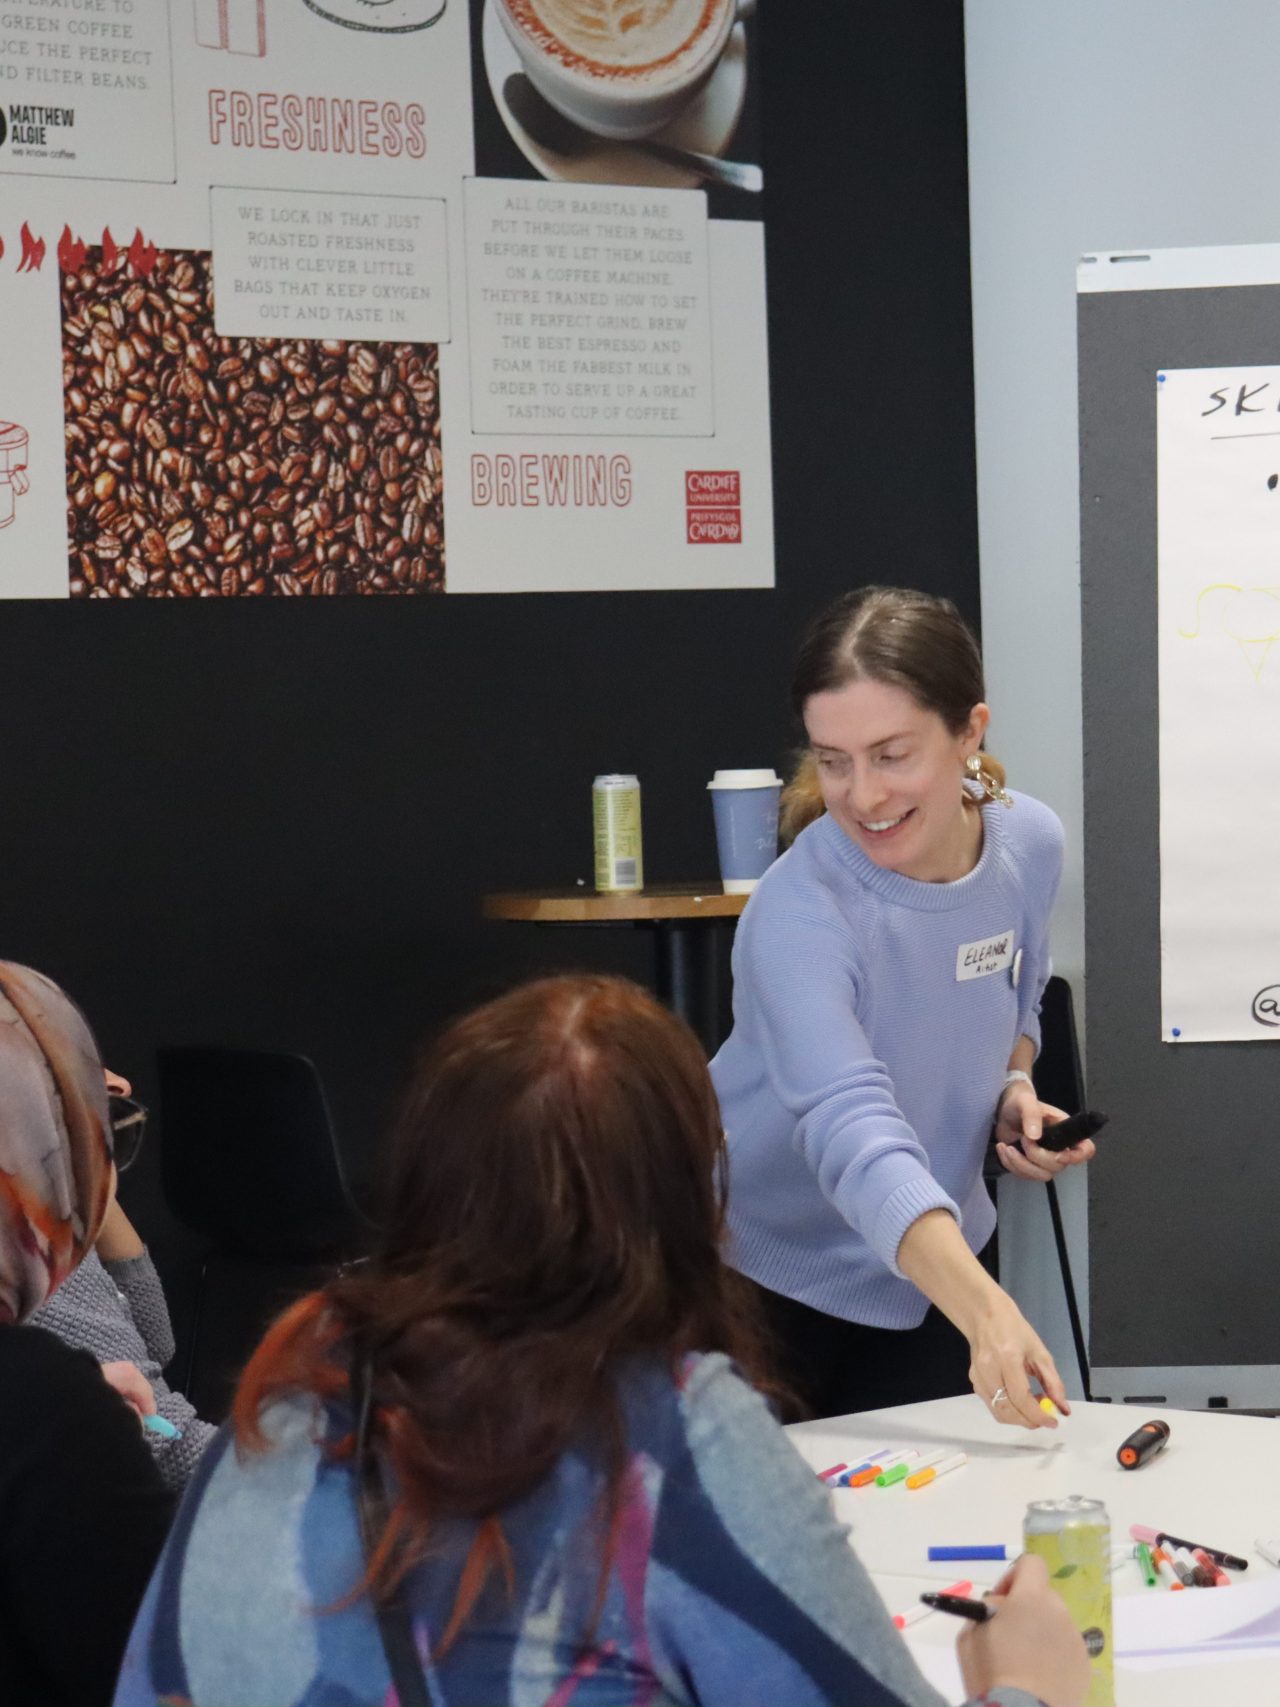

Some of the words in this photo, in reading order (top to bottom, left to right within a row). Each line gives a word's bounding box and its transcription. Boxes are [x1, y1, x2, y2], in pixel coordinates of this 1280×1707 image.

[112, 0, 134, 14] TO
[2, 14, 60, 32] GREEN
[67, 19, 133, 39] COFFEE
[36, 42, 71, 59] THE
[79, 45, 152, 65] PERFECT
[26, 67, 84, 85] FILTER
[9, 104, 75, 127] MATTHEW
[208, 88, 427, 159] FRESHNESS
[11, 124, 47, 145] ALGIE
[238, 206, 263, 222] WE
[271, 208, 310, 224] LOCK
[317, 211, 333, 225] IN
[340, 212, 379, 228] THAT
[385, 214, 421, 229] JUST
[505, 197, 531, 211] ALL
[537, 199, 565, 213] OUR
[572, 201, 636, 217] BARISTAS
[642, 204, 671, 219] ARE
[491, 219, 518, 233] PUT
[524, 221, 589, 237] THROUGH
[596, 224, 638, 238] THEIR
[248, 232, 319, 248] ROASTED
[326, 235, 415, 252] FRESHNESS
[484, 242, 539, 257] BEFORE
[545, 246, 568, 259] WE
[574, 247, 599, 260] LET
[606, 248, 644, 262] THEM
[650, 250, 693, 264] LOOSE
[248, 256, 289, 271] WITH
[296, 257, 357, 274] CLEVER
[364, 261, 415, 276] LITTLE
[505, 266, 526, 280] ON
[532, 268, 541, 281] A
[547, 268, 601, 283] COFFEE
[234, 279, 273, 294] BAGS
[279, 281, 319, 296] THAT
[326, 283, 367, 297] KEEP
[372, 285, 431, 299] OXYGEN
[546, 290, 609, 306] TRAINED
[615, 295, 645, 307] HOW
[651, 295, 668, 309] TO
[674, 296, 698, 309] SET
[259, 304, 290, 319] OUT
[296, 306, 330, 320] AND
[337, 308, 383, 322] TASTE
[495, 312, 524, 326] THE
[530, 314, 593, 328] PERFECT
[648, 317, 687, 331] BREW
[502, 335, 531, 349] THE
[538, 336, 572, 351] BEST
[578, 338, 646, 352] ESPRESSO
[652, 340, 681, 353] AND
[492, 358, 532, 372] FOAM
[538, 360, 566, 373] THE
[638, 362, 671, 376] MILK
[677, 362, 691, 376] IN
[489, 381, 536, 396] ORDER
[542, 383, 560, 396] TO
[566, 384, 610, 397] SERVE
[617, 385, 635, 398] UP
[639, 386, 649, 398] A
[654, 385, 696, 398] GREAT
[506, 405, 566, 419] TASTING
[571, 406, 598, 419] CUP
[603, 407, 621, 419] OF
[471, 455, 632, 506] BREWING
[688, 474, 737, 492] CARDIFF
